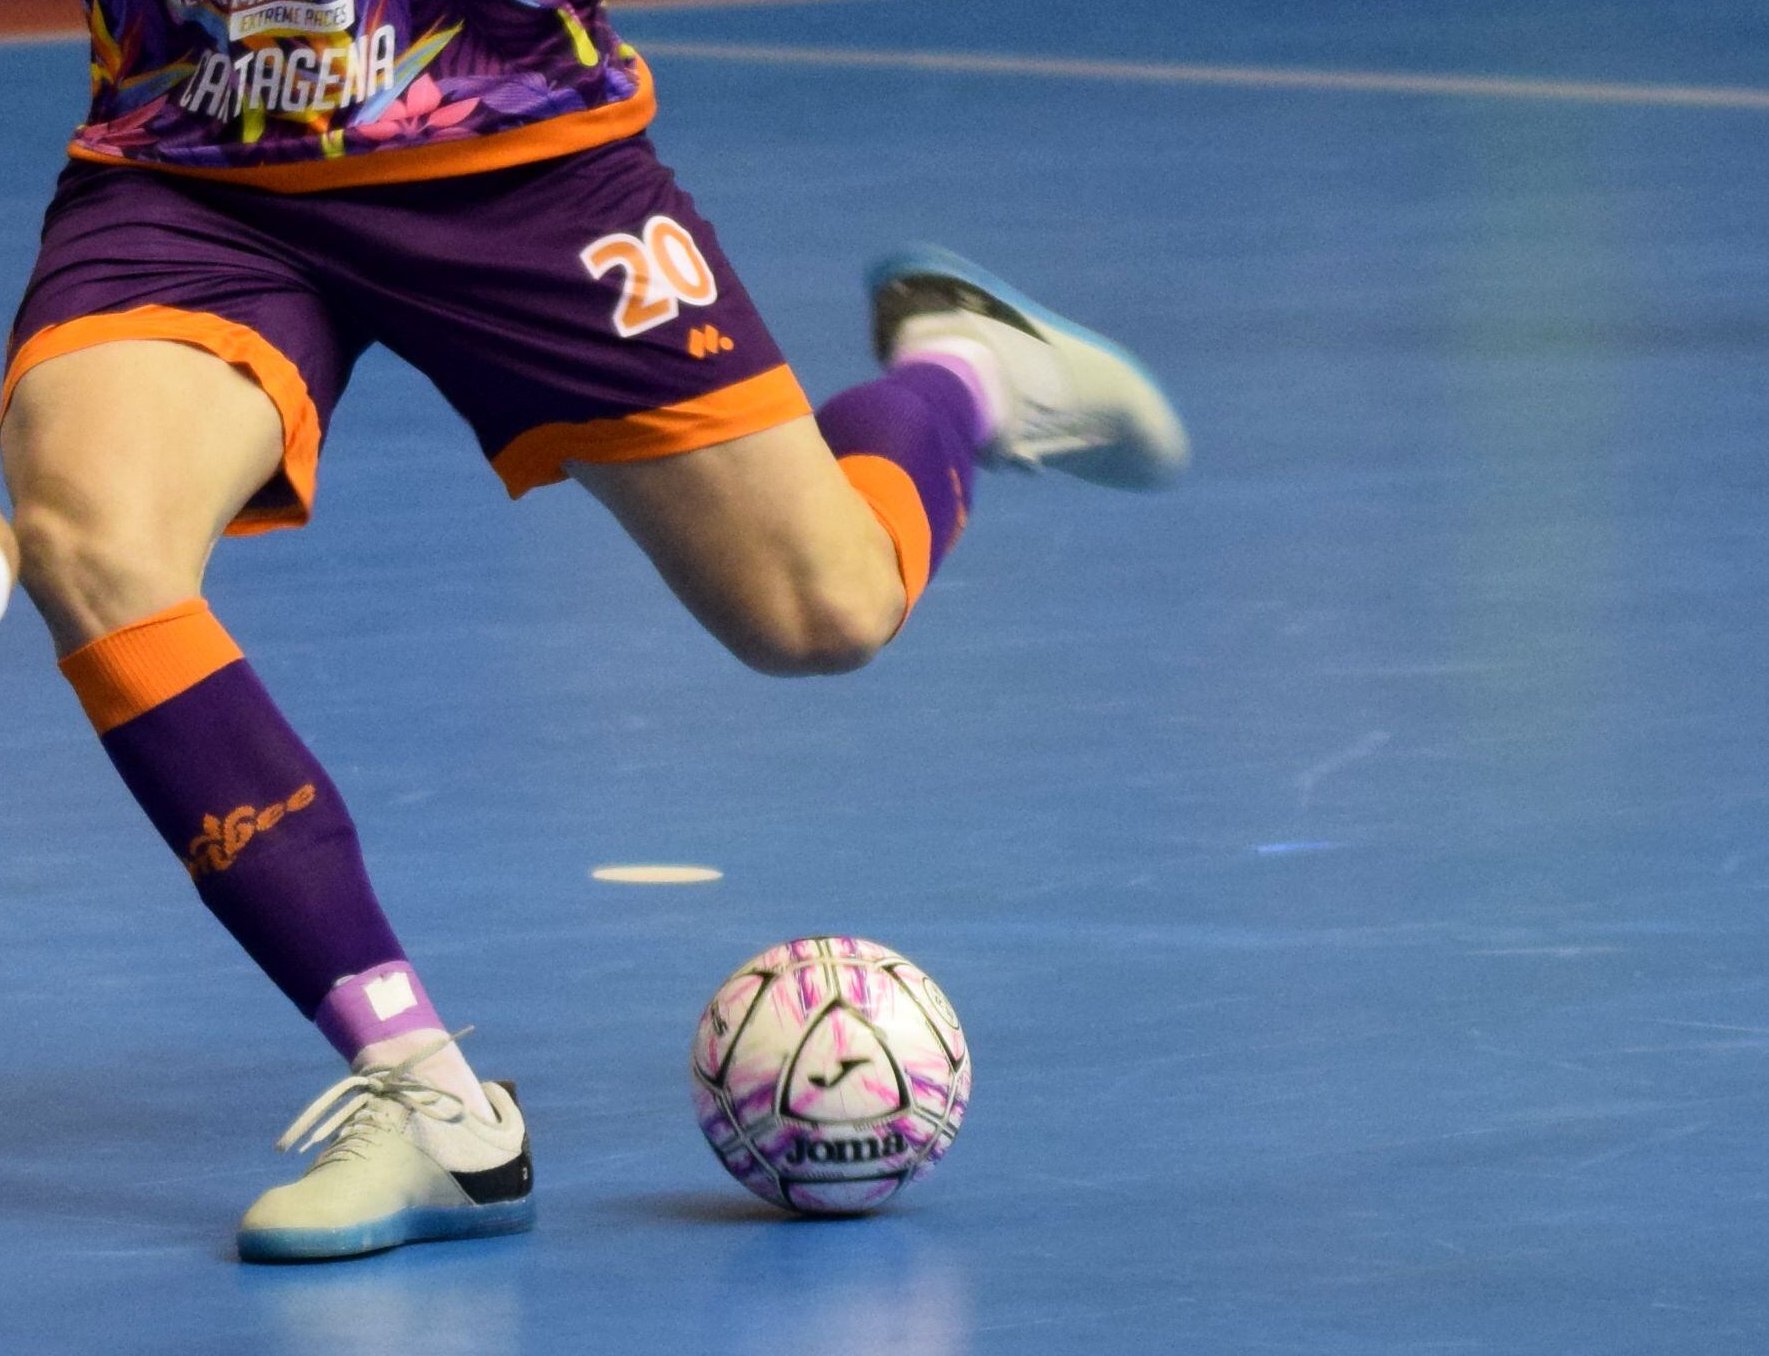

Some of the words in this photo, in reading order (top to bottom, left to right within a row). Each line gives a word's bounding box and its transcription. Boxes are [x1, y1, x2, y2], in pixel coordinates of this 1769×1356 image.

[240, 5, 300, 32] EXTREME
[579, 215, 719, 338] 20
[785, 1131, 908, 1165] Joma
